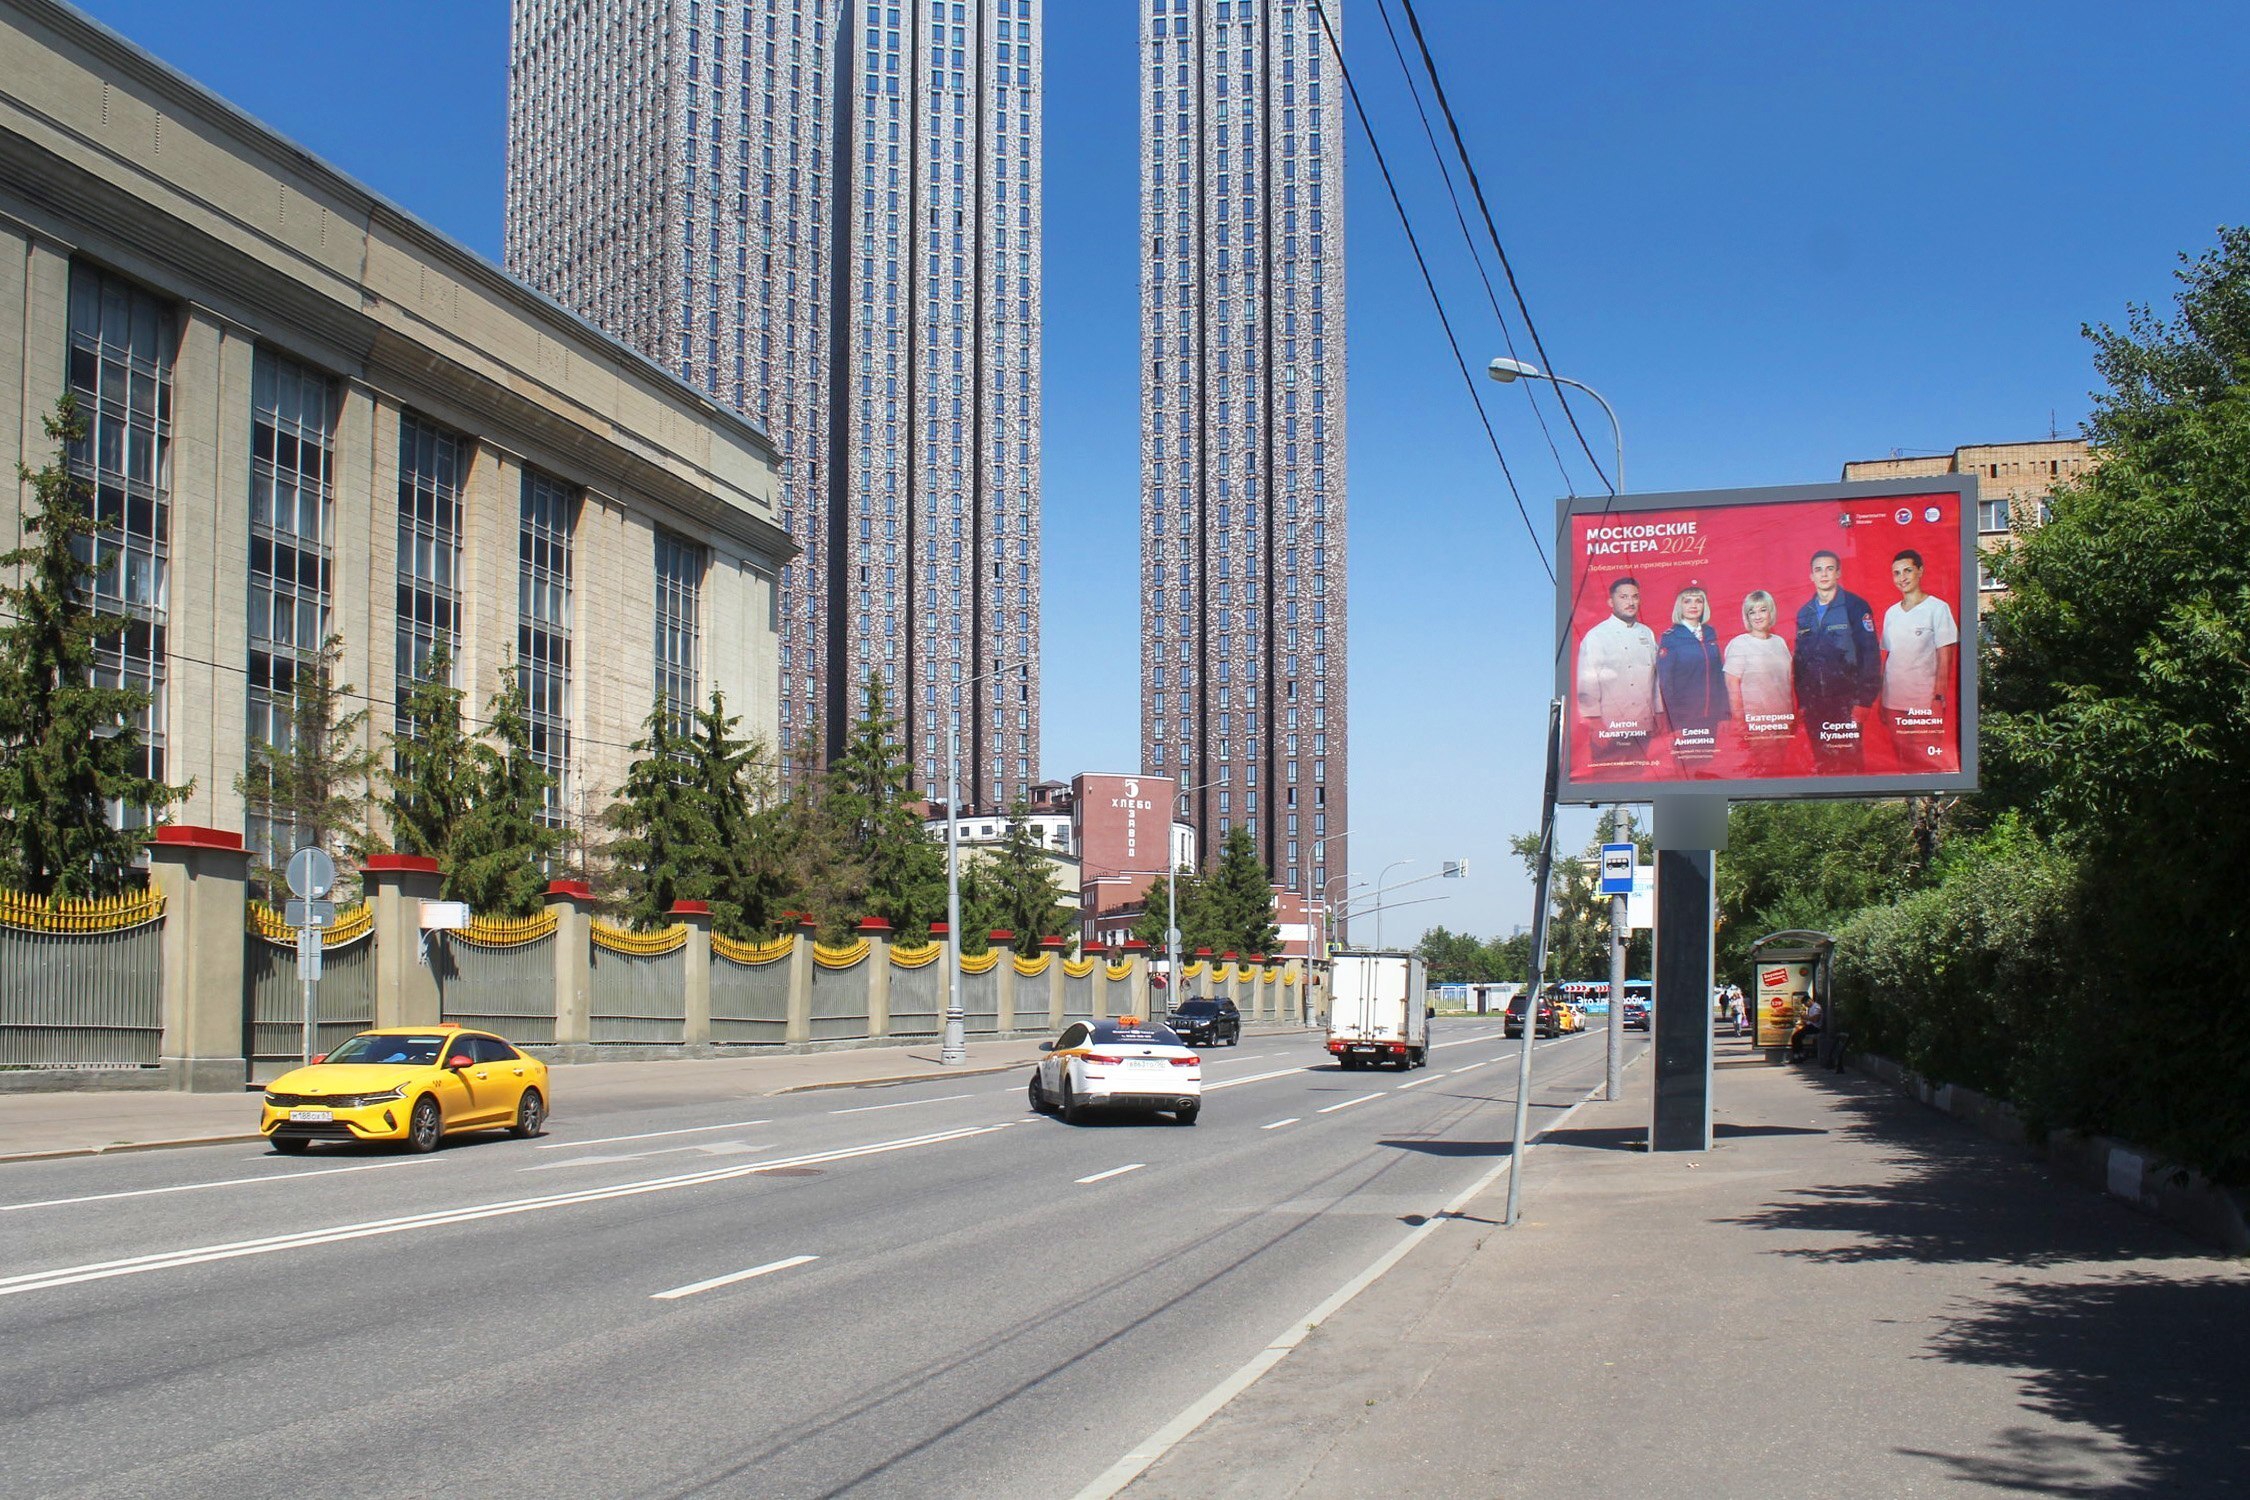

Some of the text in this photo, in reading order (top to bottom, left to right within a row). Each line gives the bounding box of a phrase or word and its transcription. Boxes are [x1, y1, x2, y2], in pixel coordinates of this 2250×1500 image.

[1586, 521, 1698, 541] МОСКОВСКИЕ
[1586, 535, 1708, 556] МАСТЕРА 2024
[1907, 707, 1933, 716] Анна
[1745, 713, 1795, 723] Екатерина
[1895, 717, 1944, 726] Товмасян
[1609, 720, 1638, 729] Антон
[1748, 722, 1789, 732] Киреева
[1822, 720, 1858, 731] Сергей
[1598, 729, 1647, 739] Калатухин
[1682, 728, 1710, 736] Елена
[1820, 731, 1860, 741] Кульнев
[1674, 736, 1715, 746] Аникина
[1927, 745, 1943, 756] 0+
[1124, 779, 1139, 798] 5
[1111, 799, 1152, 810] ХЛЕБО
